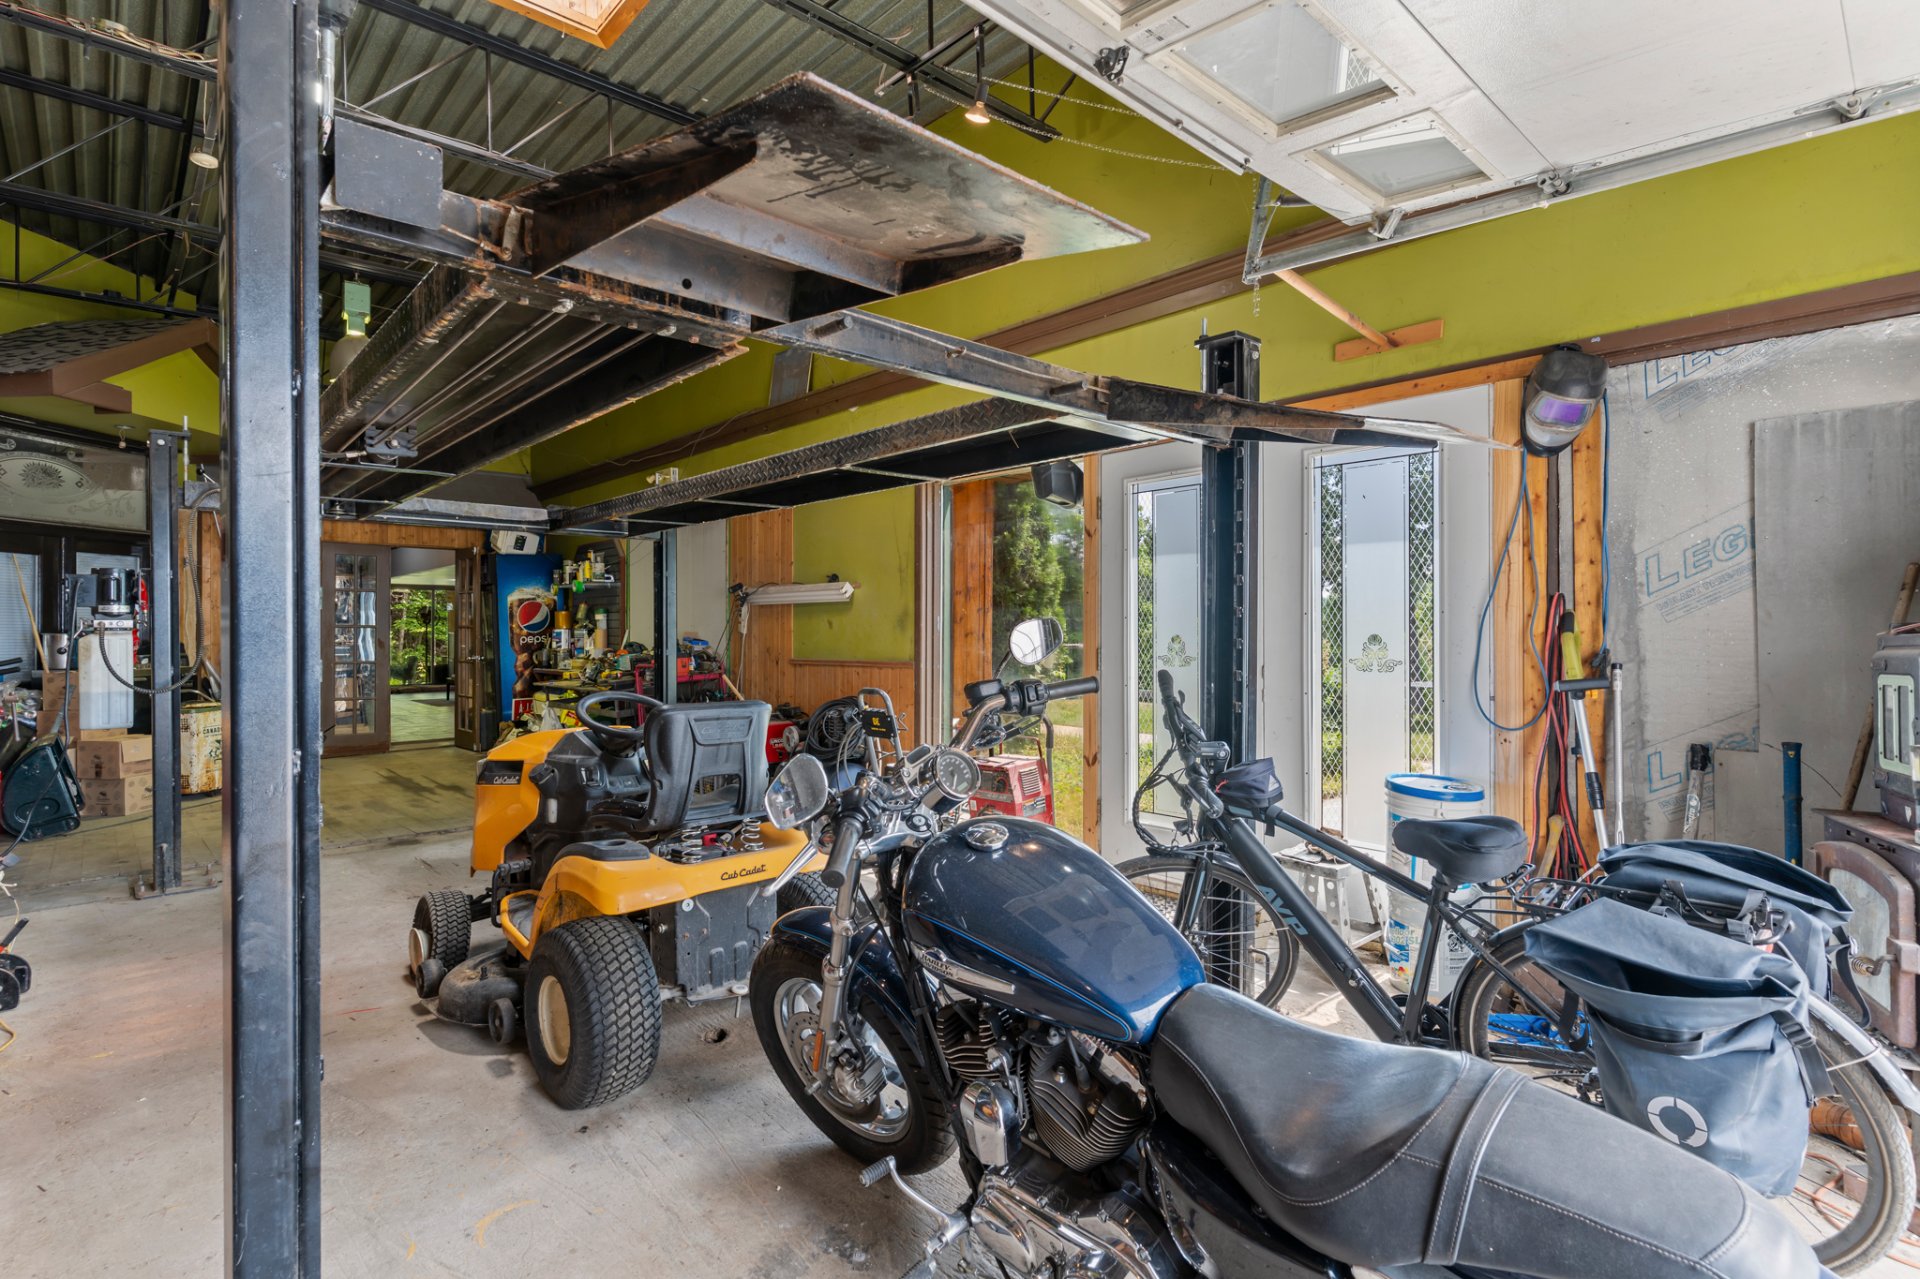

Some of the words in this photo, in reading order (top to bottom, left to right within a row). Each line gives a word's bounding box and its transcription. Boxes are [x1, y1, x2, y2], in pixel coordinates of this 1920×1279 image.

[1644, 346, 1738, 400] LE
[720, 870, 738, 881] Cub
[739, 864, 766, 877] Cadet
